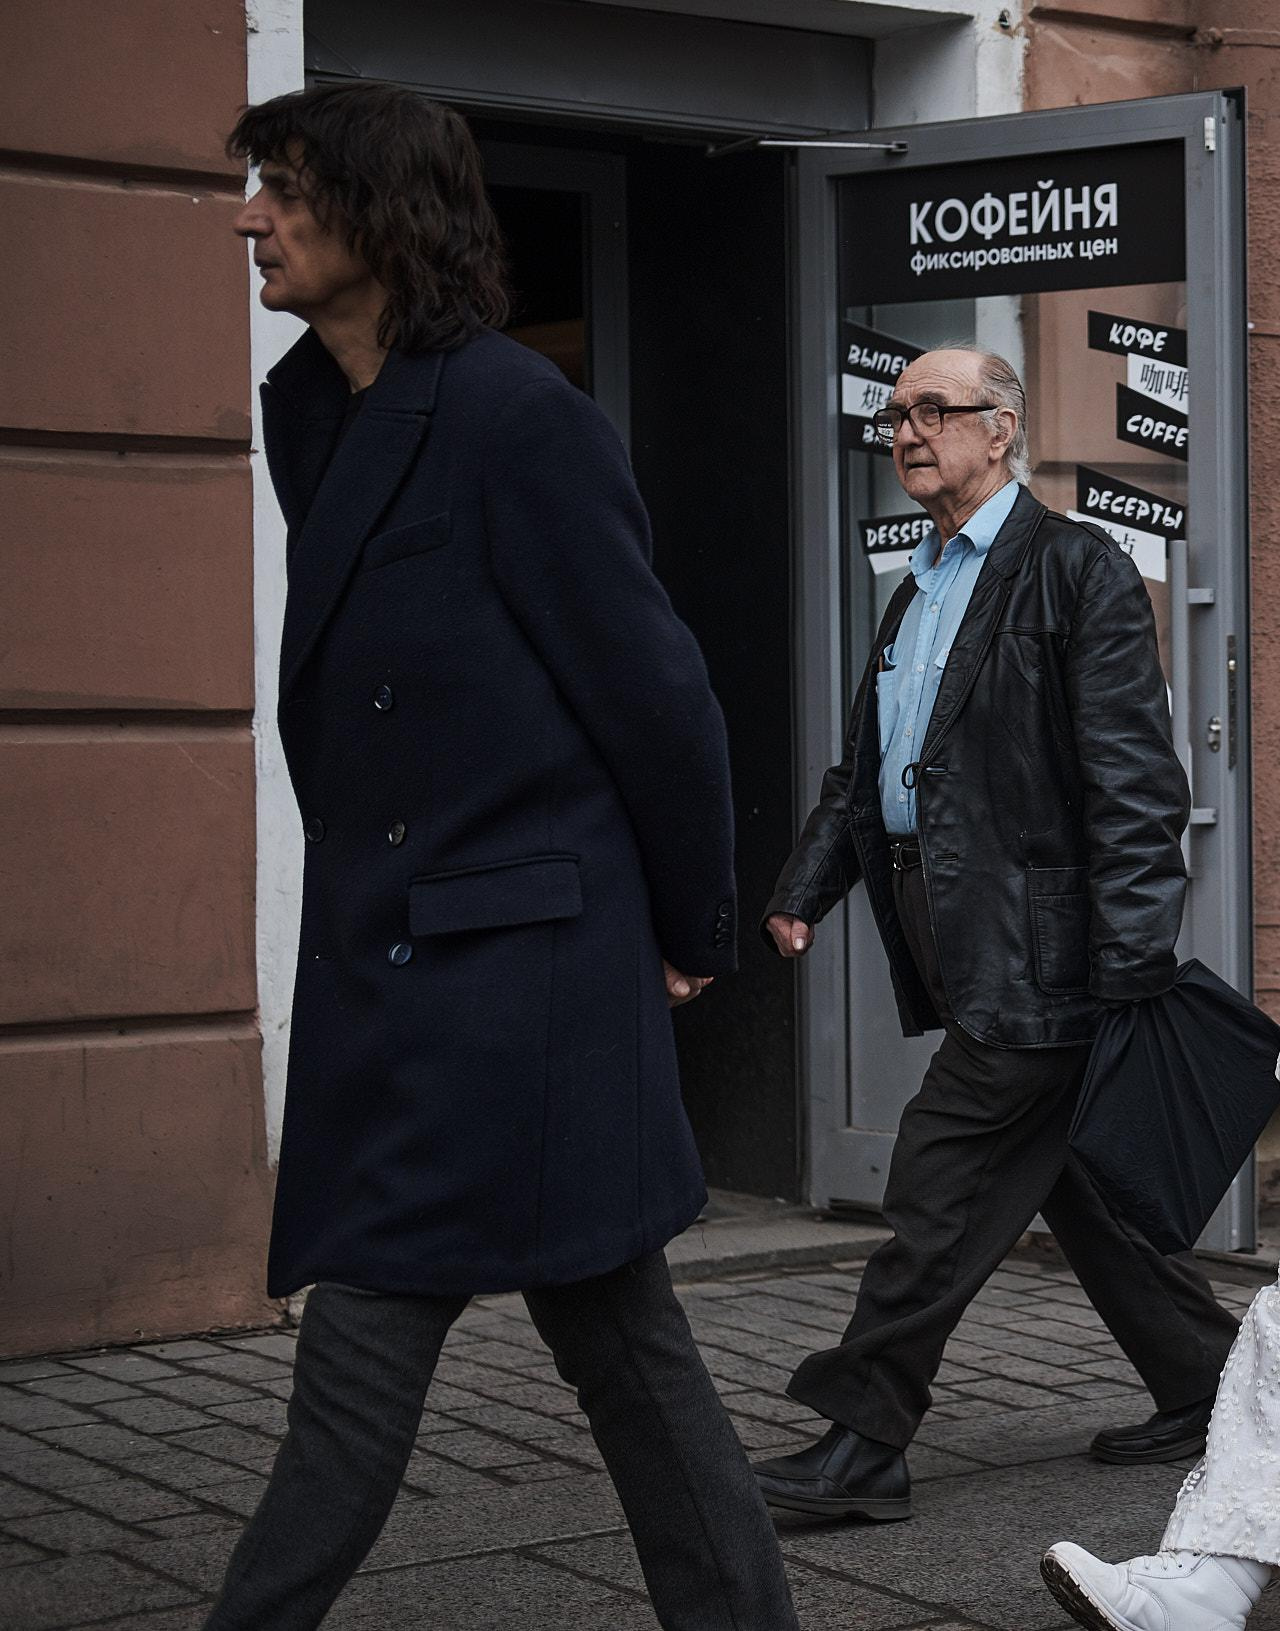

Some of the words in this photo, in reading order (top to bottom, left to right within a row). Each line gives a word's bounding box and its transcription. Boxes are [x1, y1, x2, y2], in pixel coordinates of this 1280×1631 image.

[909, 179, 1118, 245] КОФЕЙНЯ
[910, 241, 1074, 277] фиксированных
[1079, 237, 1118, 260] цен
[1108, 322, 1168, 352] КОФЕ
